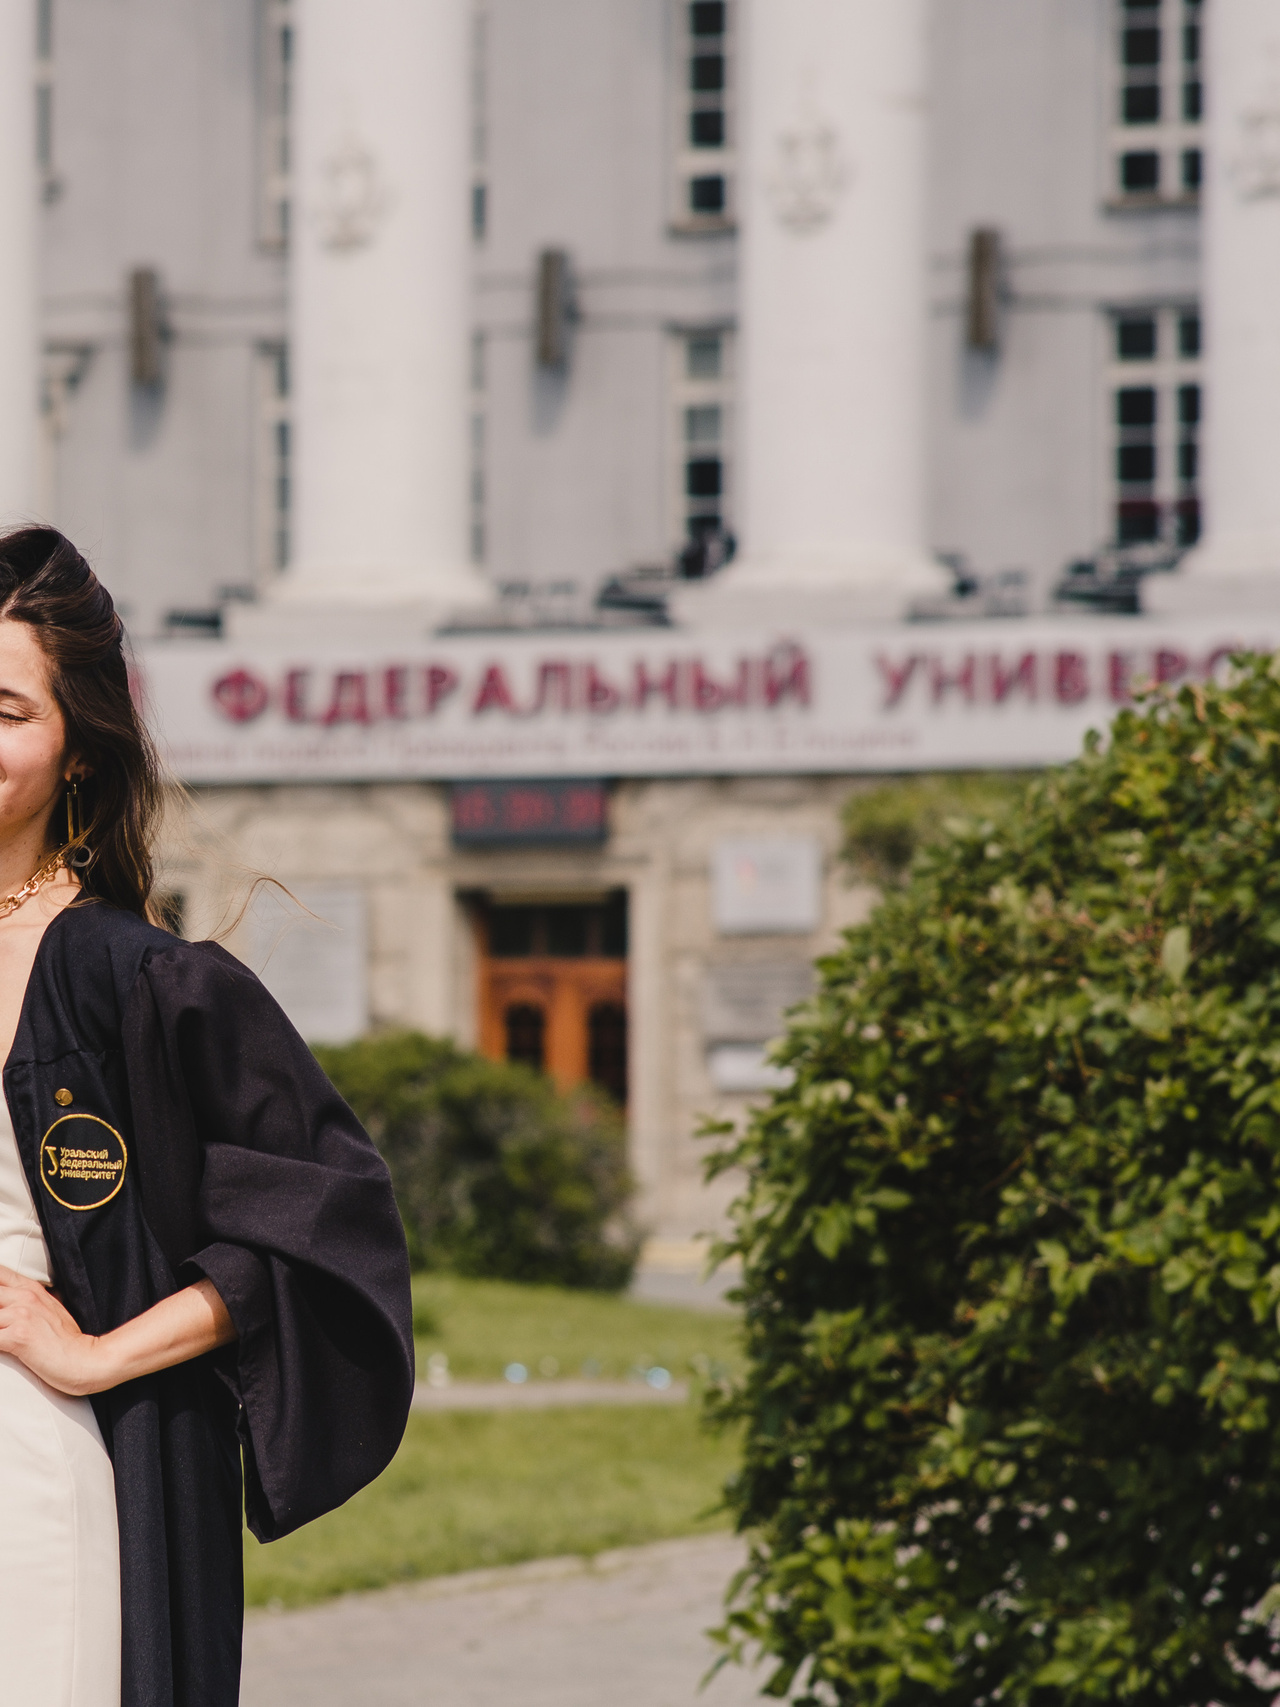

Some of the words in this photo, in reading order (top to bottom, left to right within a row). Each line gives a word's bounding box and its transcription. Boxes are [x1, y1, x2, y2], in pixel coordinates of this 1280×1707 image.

[211, 640, 813, 727] ФЕДЕРАЛЬНЫЙ
[60, 1147, 109, 1160] Уральский
[60, 1157, 123, 1170] федеральный
[60, 1168, 117, 1181] университет
